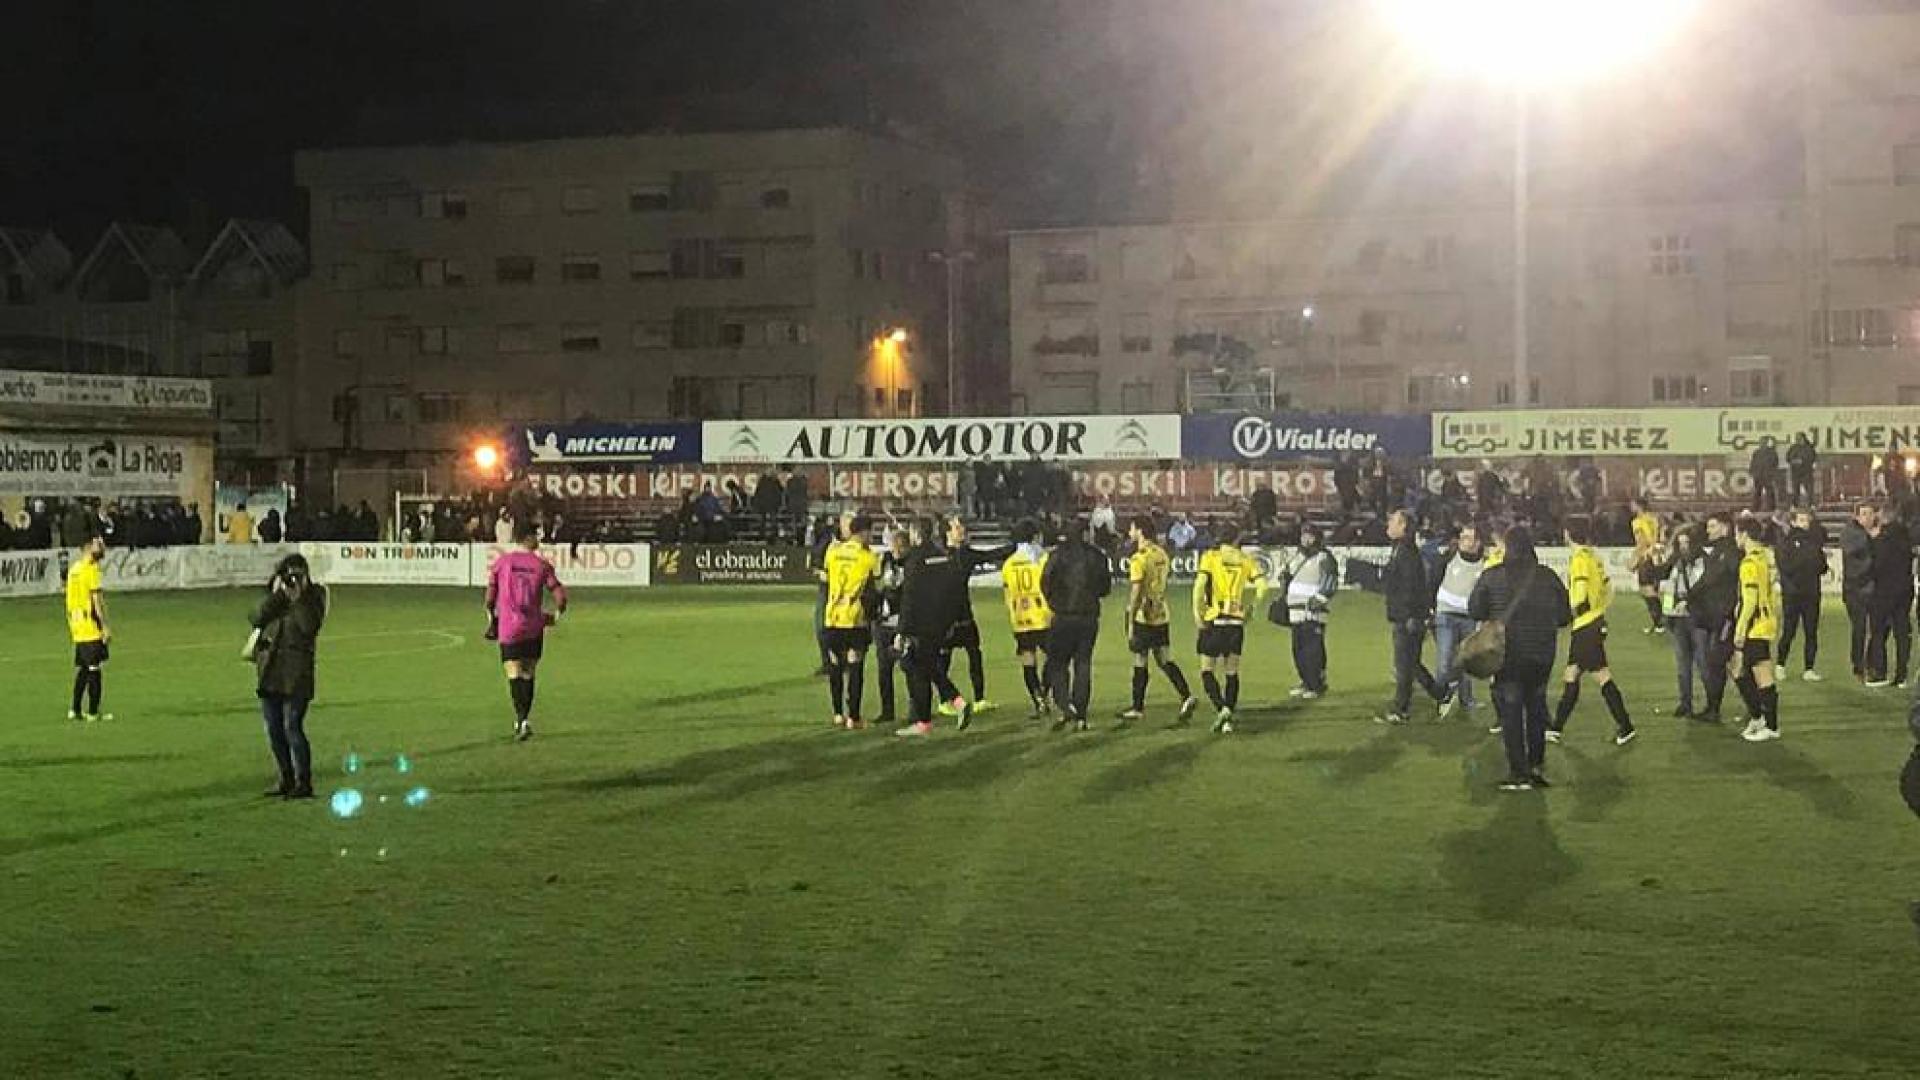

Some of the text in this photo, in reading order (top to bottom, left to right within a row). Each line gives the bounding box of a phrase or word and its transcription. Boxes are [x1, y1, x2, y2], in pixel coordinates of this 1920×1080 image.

[564, 435, 676, 453] MICHELIN
[786, 422, 1087, 458] AUTOMOTOR
[1519, 428, 1669, 451] JIMENEZ
[62, 443, 82, 472] de
[121, 444, 140, 472] La
[341, 547, 376, 559] DON
[714, 549, 787, 568] obrador
[1013, 567, 1033, 592] 10
[1221, 569, 1240, 596] 7
